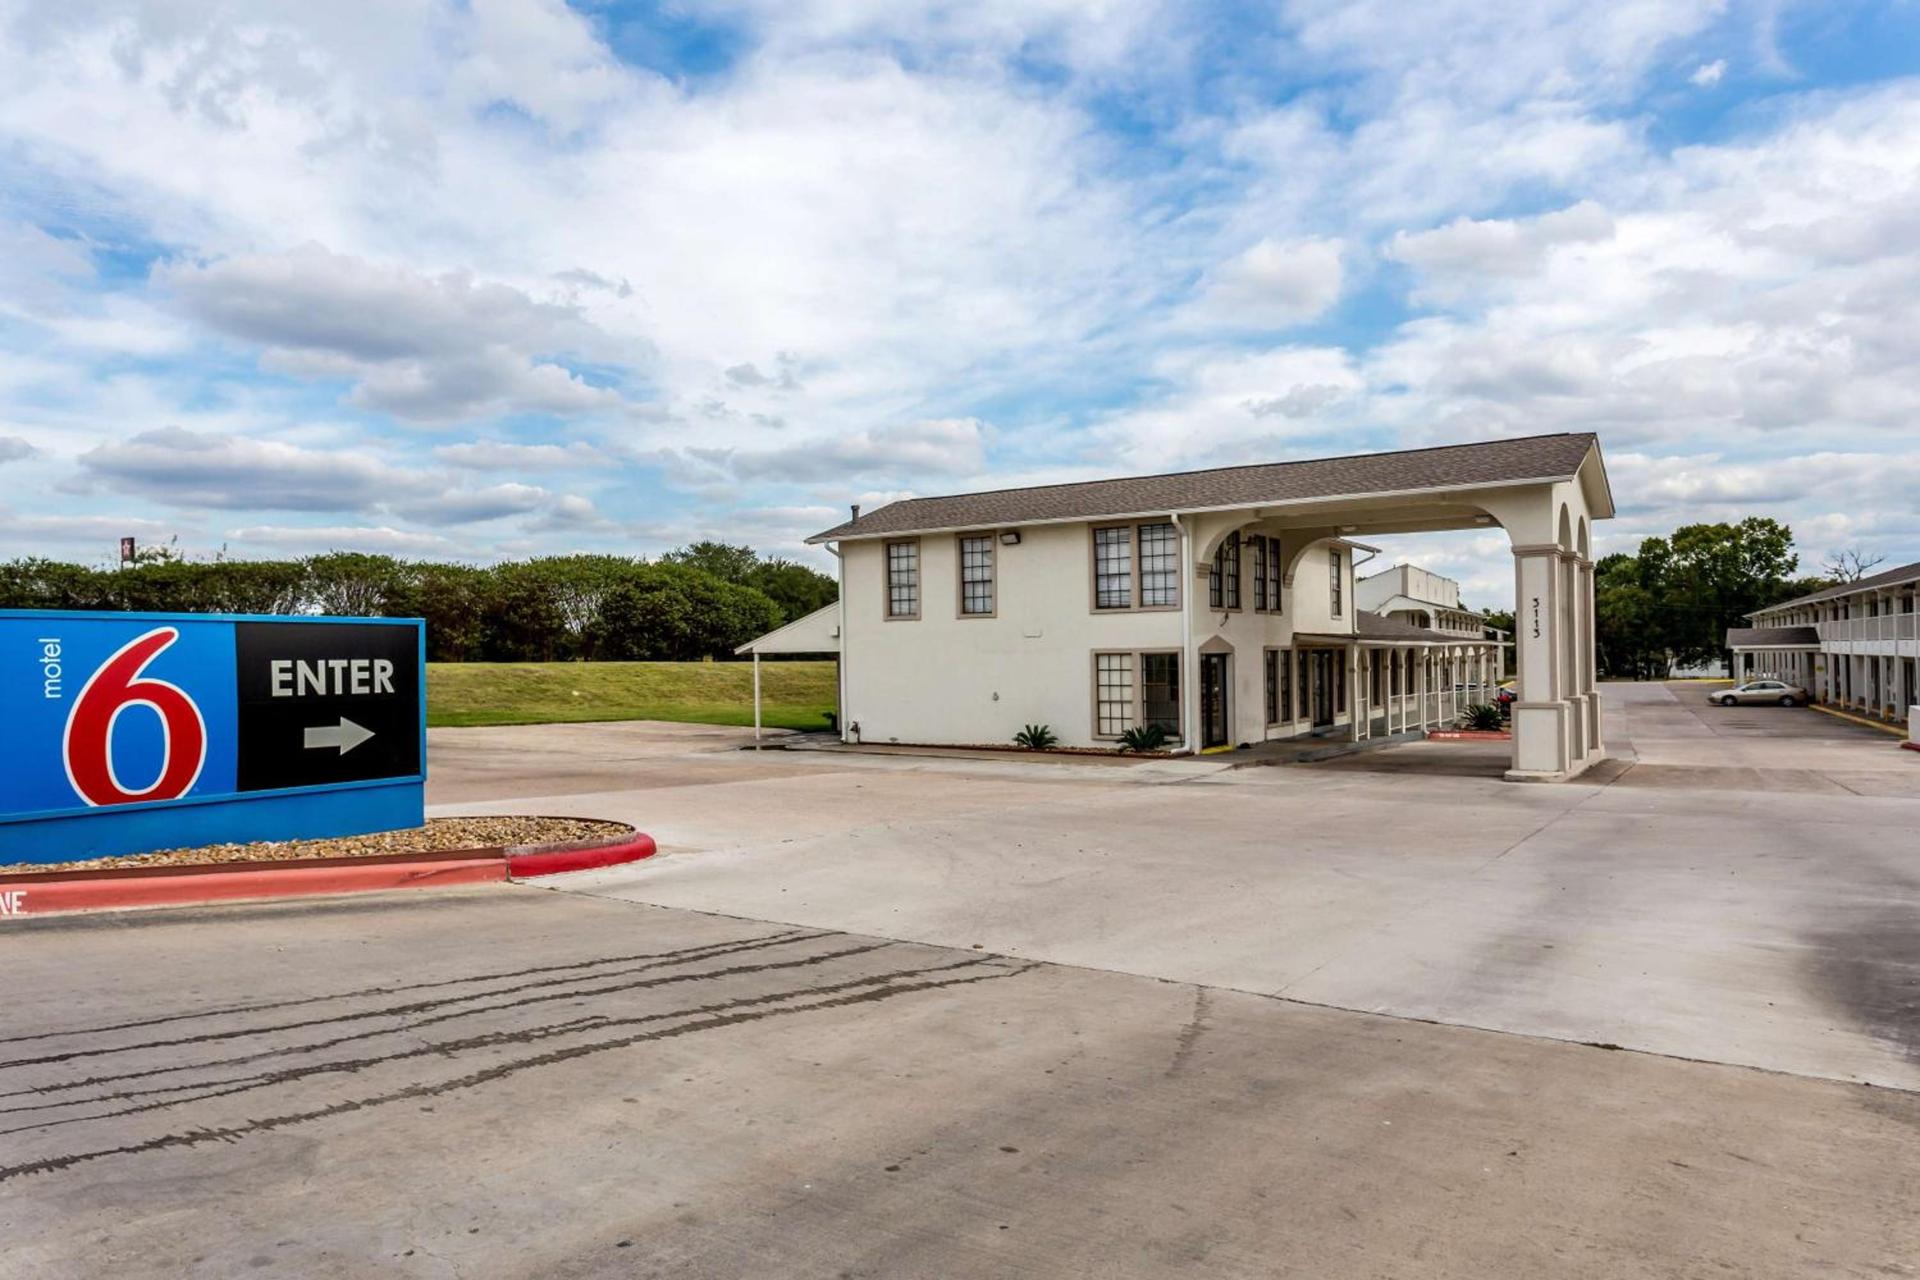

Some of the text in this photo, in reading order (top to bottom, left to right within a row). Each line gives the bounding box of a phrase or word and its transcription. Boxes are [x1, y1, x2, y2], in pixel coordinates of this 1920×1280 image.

[38, 626, 207, 806] motel 6
[271, 659, 394, 697] ENTER
